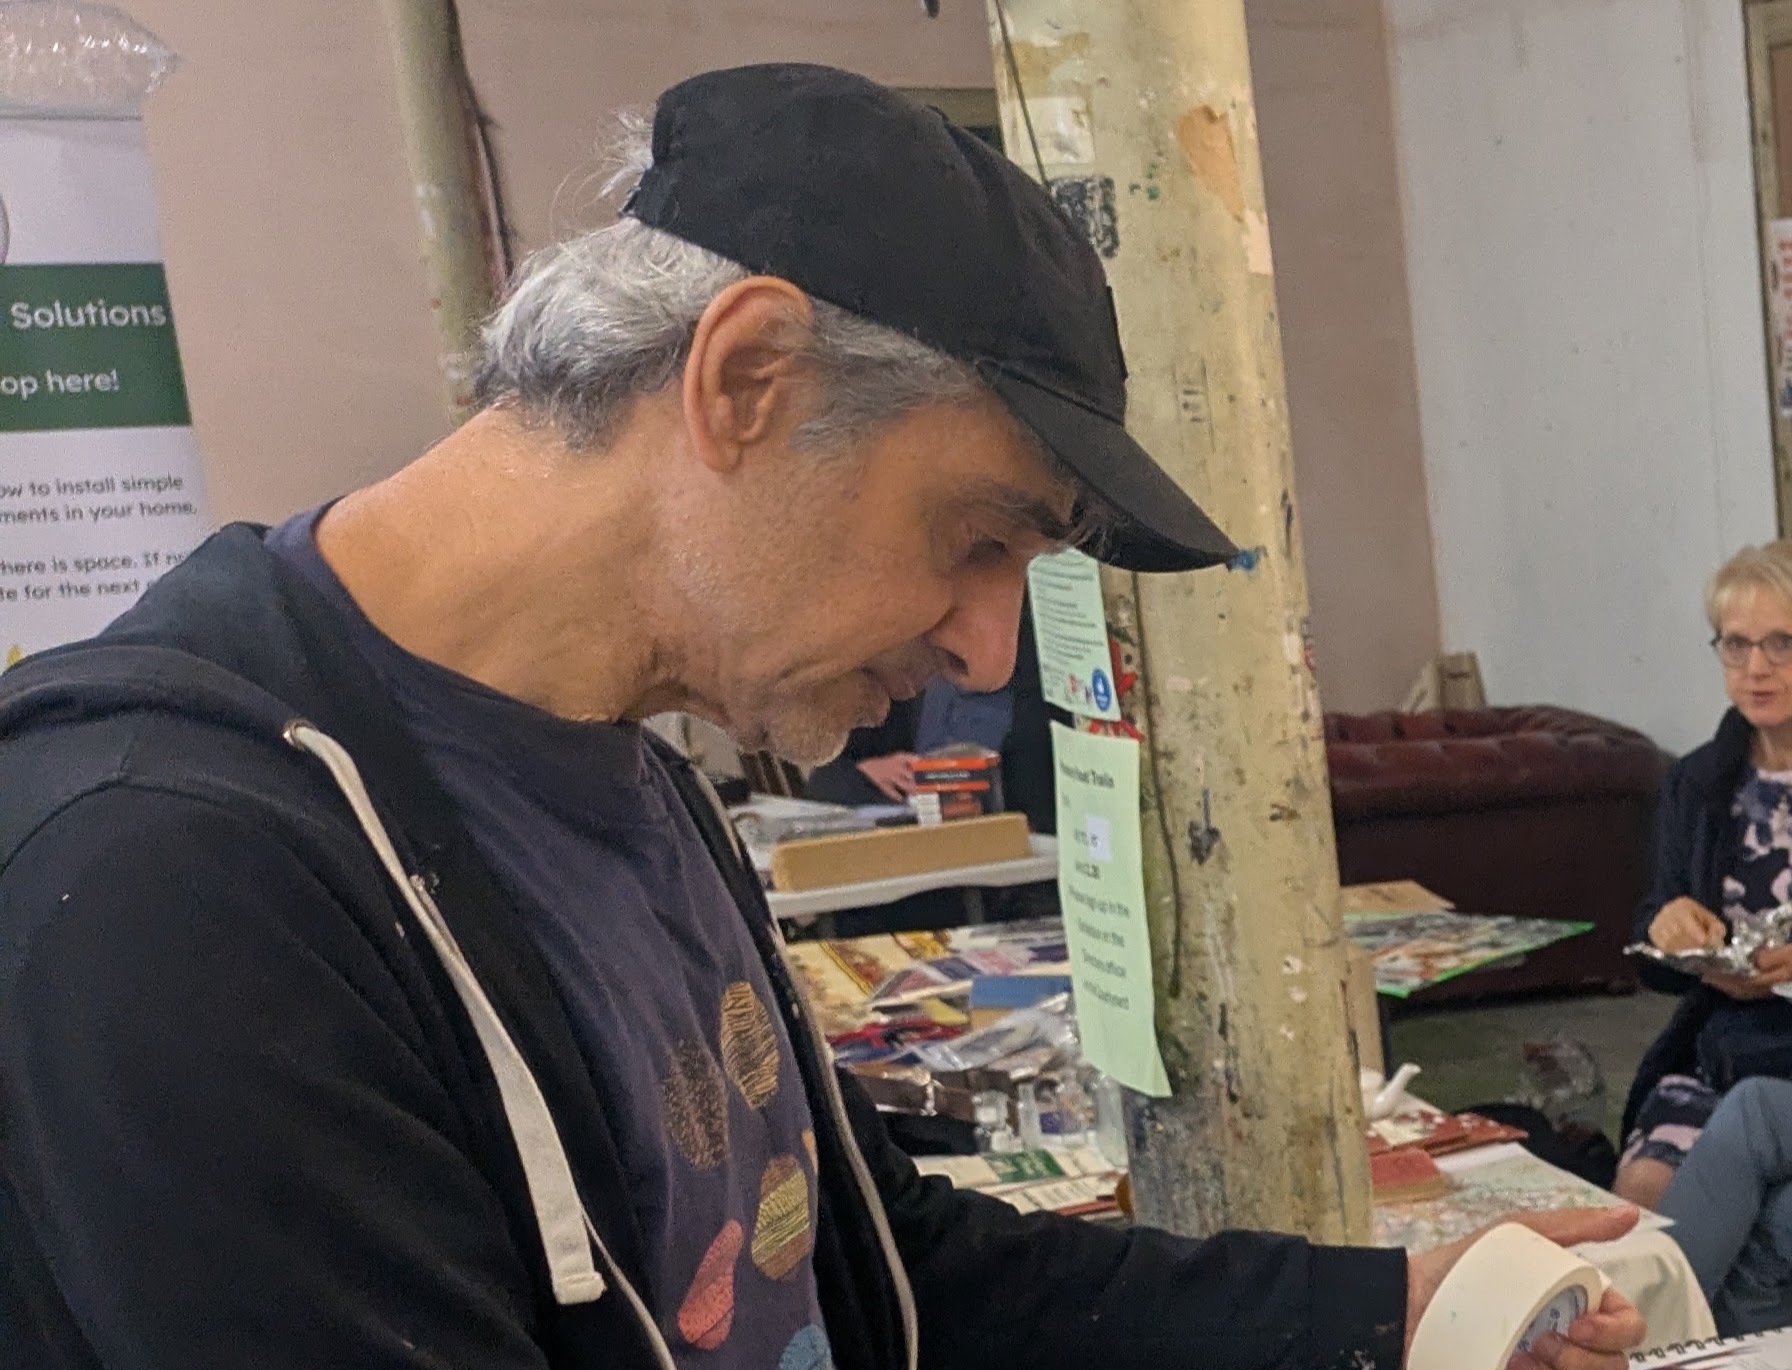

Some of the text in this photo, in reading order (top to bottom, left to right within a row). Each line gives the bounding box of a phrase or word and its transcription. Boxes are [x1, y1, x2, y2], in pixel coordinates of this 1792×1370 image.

[10, 299, 167, 330] Solutions
[46, 368, 120, 393] here!
[29, 481, 51, 496] to
[56, 477, 116, 495] install
[121, 472, 185, 493] simple
[65, 503, 84, 520] in
[89, 506, 134, 523] your
[52, 556, 68, 574] is
[74, 554, 138, 574] space.
[25, 584, 50, 600] for
[60, 581, 90, 599] the
